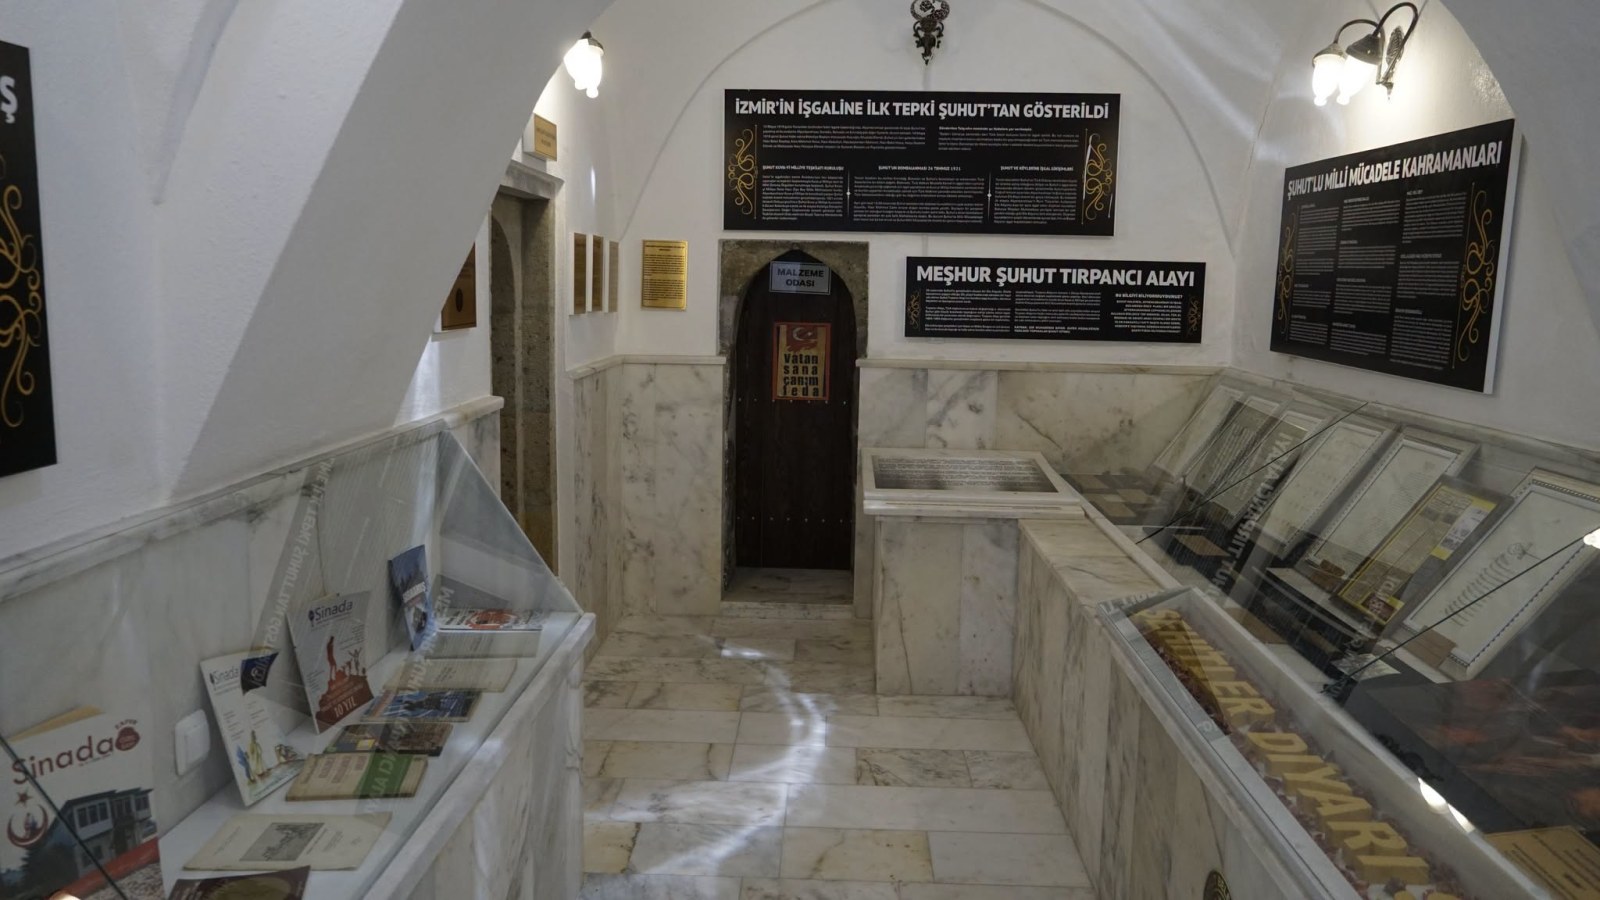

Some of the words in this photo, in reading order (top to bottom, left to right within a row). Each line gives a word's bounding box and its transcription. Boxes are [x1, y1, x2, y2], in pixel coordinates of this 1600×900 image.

[735, 97, 794, 115] İZMİR'İN
[798, 98, 863, 118] İŞGALİNE
[867, 99, 890, 115] İLK
[893, 99, 935, 116] TEPKİ
[938, 101, 1020, 120] ŞUHUT'TAN
[1023, 101, 1109, 119] GÖSTERİLDİ
[1324, 165, 1349, 191] MİLLİ
[1348, 159, 1401, 186] MÜCADELE
[1402, 141, 1503, 179] KAHRAMANLARI
[777, 268, 824, 278] MALZEME
[785, 278, 815, 288] ODASI
[916, 265, 991, 286] MEŞHUR
[996, 266, 1057, 287] ŞUHUT
[1060, 268, 1142, 286] TIRPANCI
[1146, 270, 1195, 287] ALAYI
[783, 365, 818, 375] sana
[314, 600, 353, 620] Sinada
[11, 735, 114, 785] Sinada
